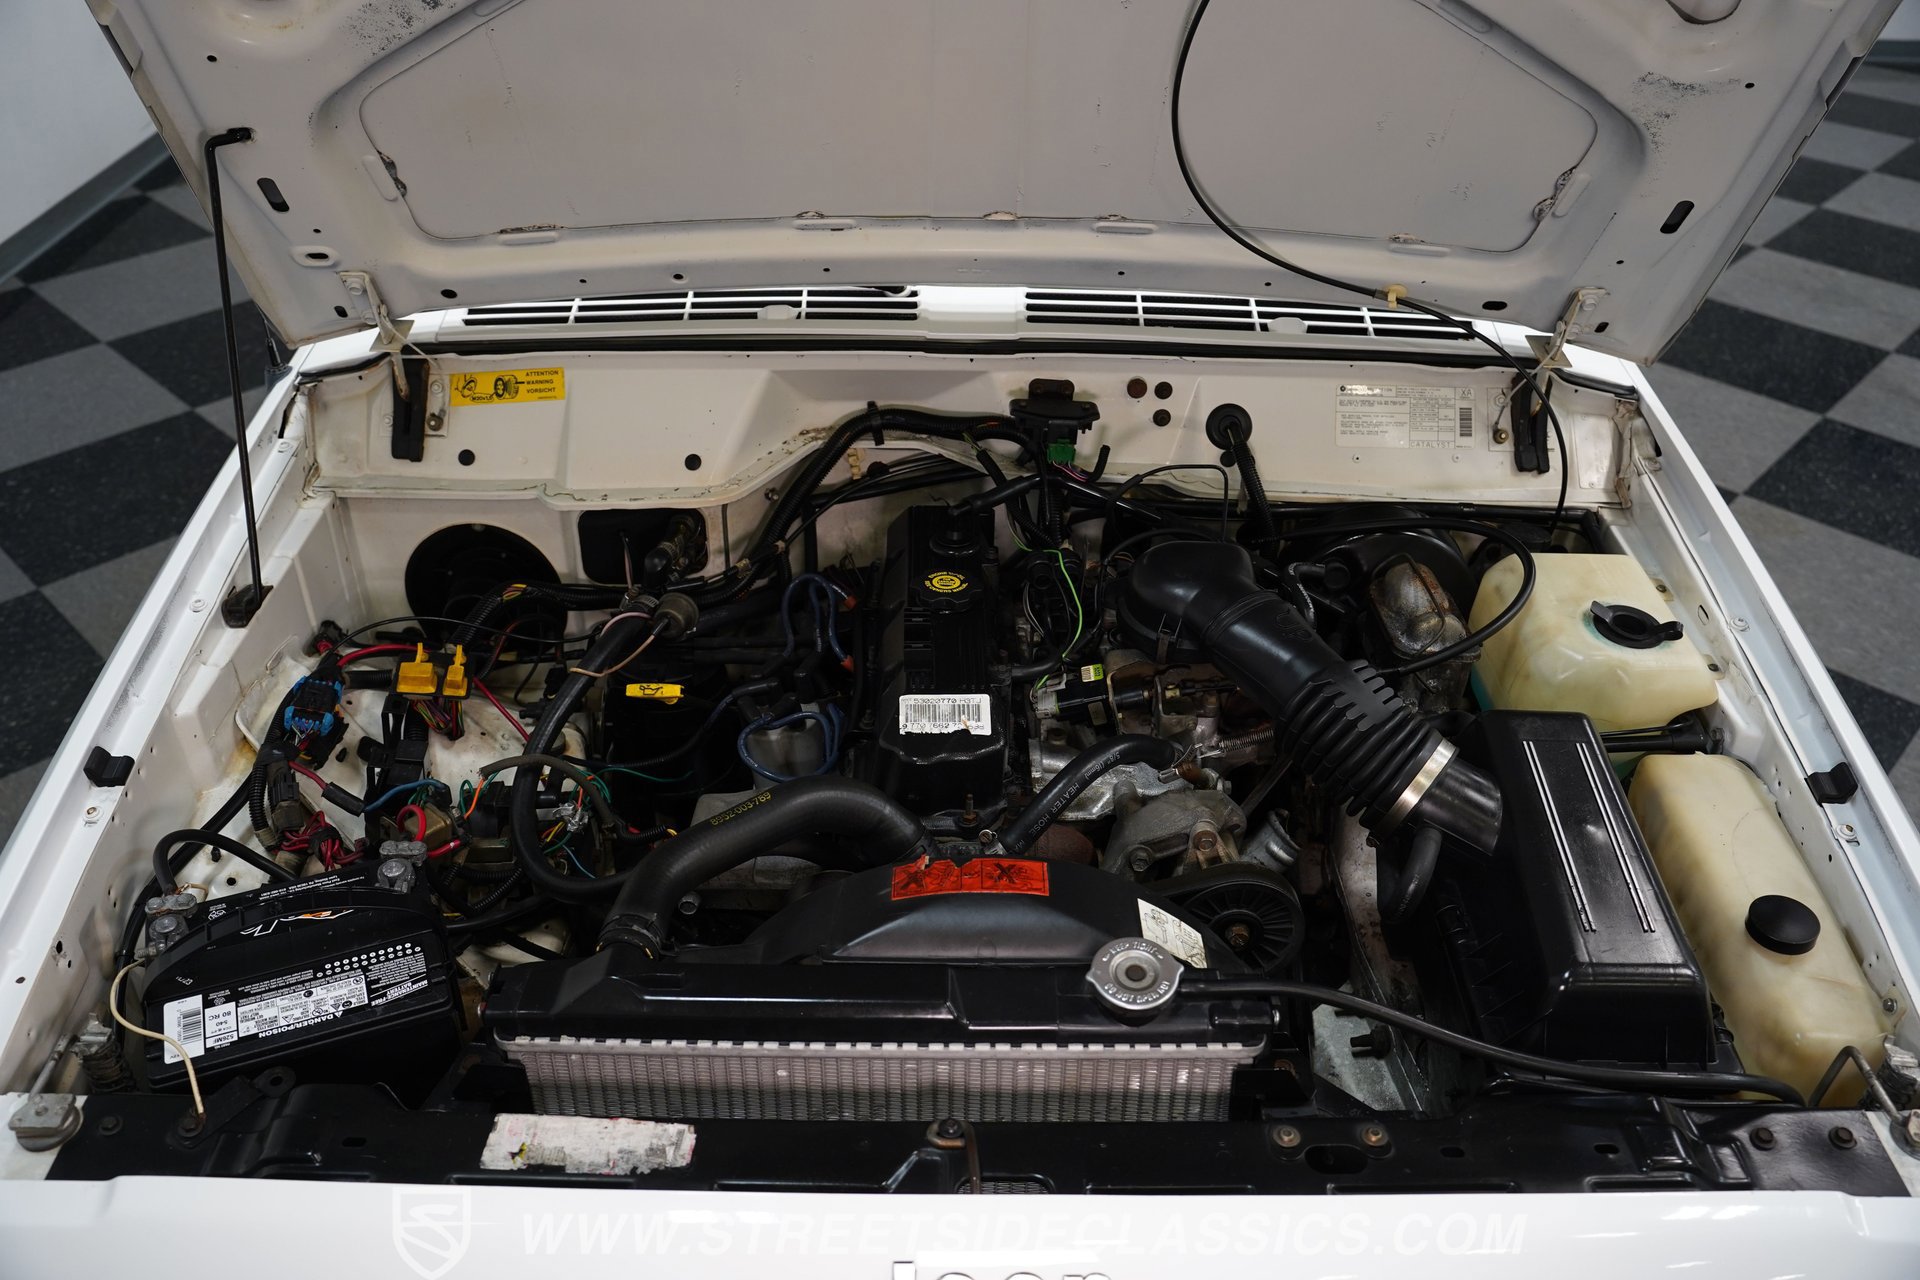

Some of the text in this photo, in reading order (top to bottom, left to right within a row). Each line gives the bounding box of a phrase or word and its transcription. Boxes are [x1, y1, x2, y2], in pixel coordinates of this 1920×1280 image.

[1410, 440, 1450, 448] CATALYST
[1050, 782, 1080, 814] HEATER
[1028, 813, 1052, 835] HOSE
[259, 1014, 334, 1038] DANGER/POISON
[212, 1033, 234, 1043] 526MF
